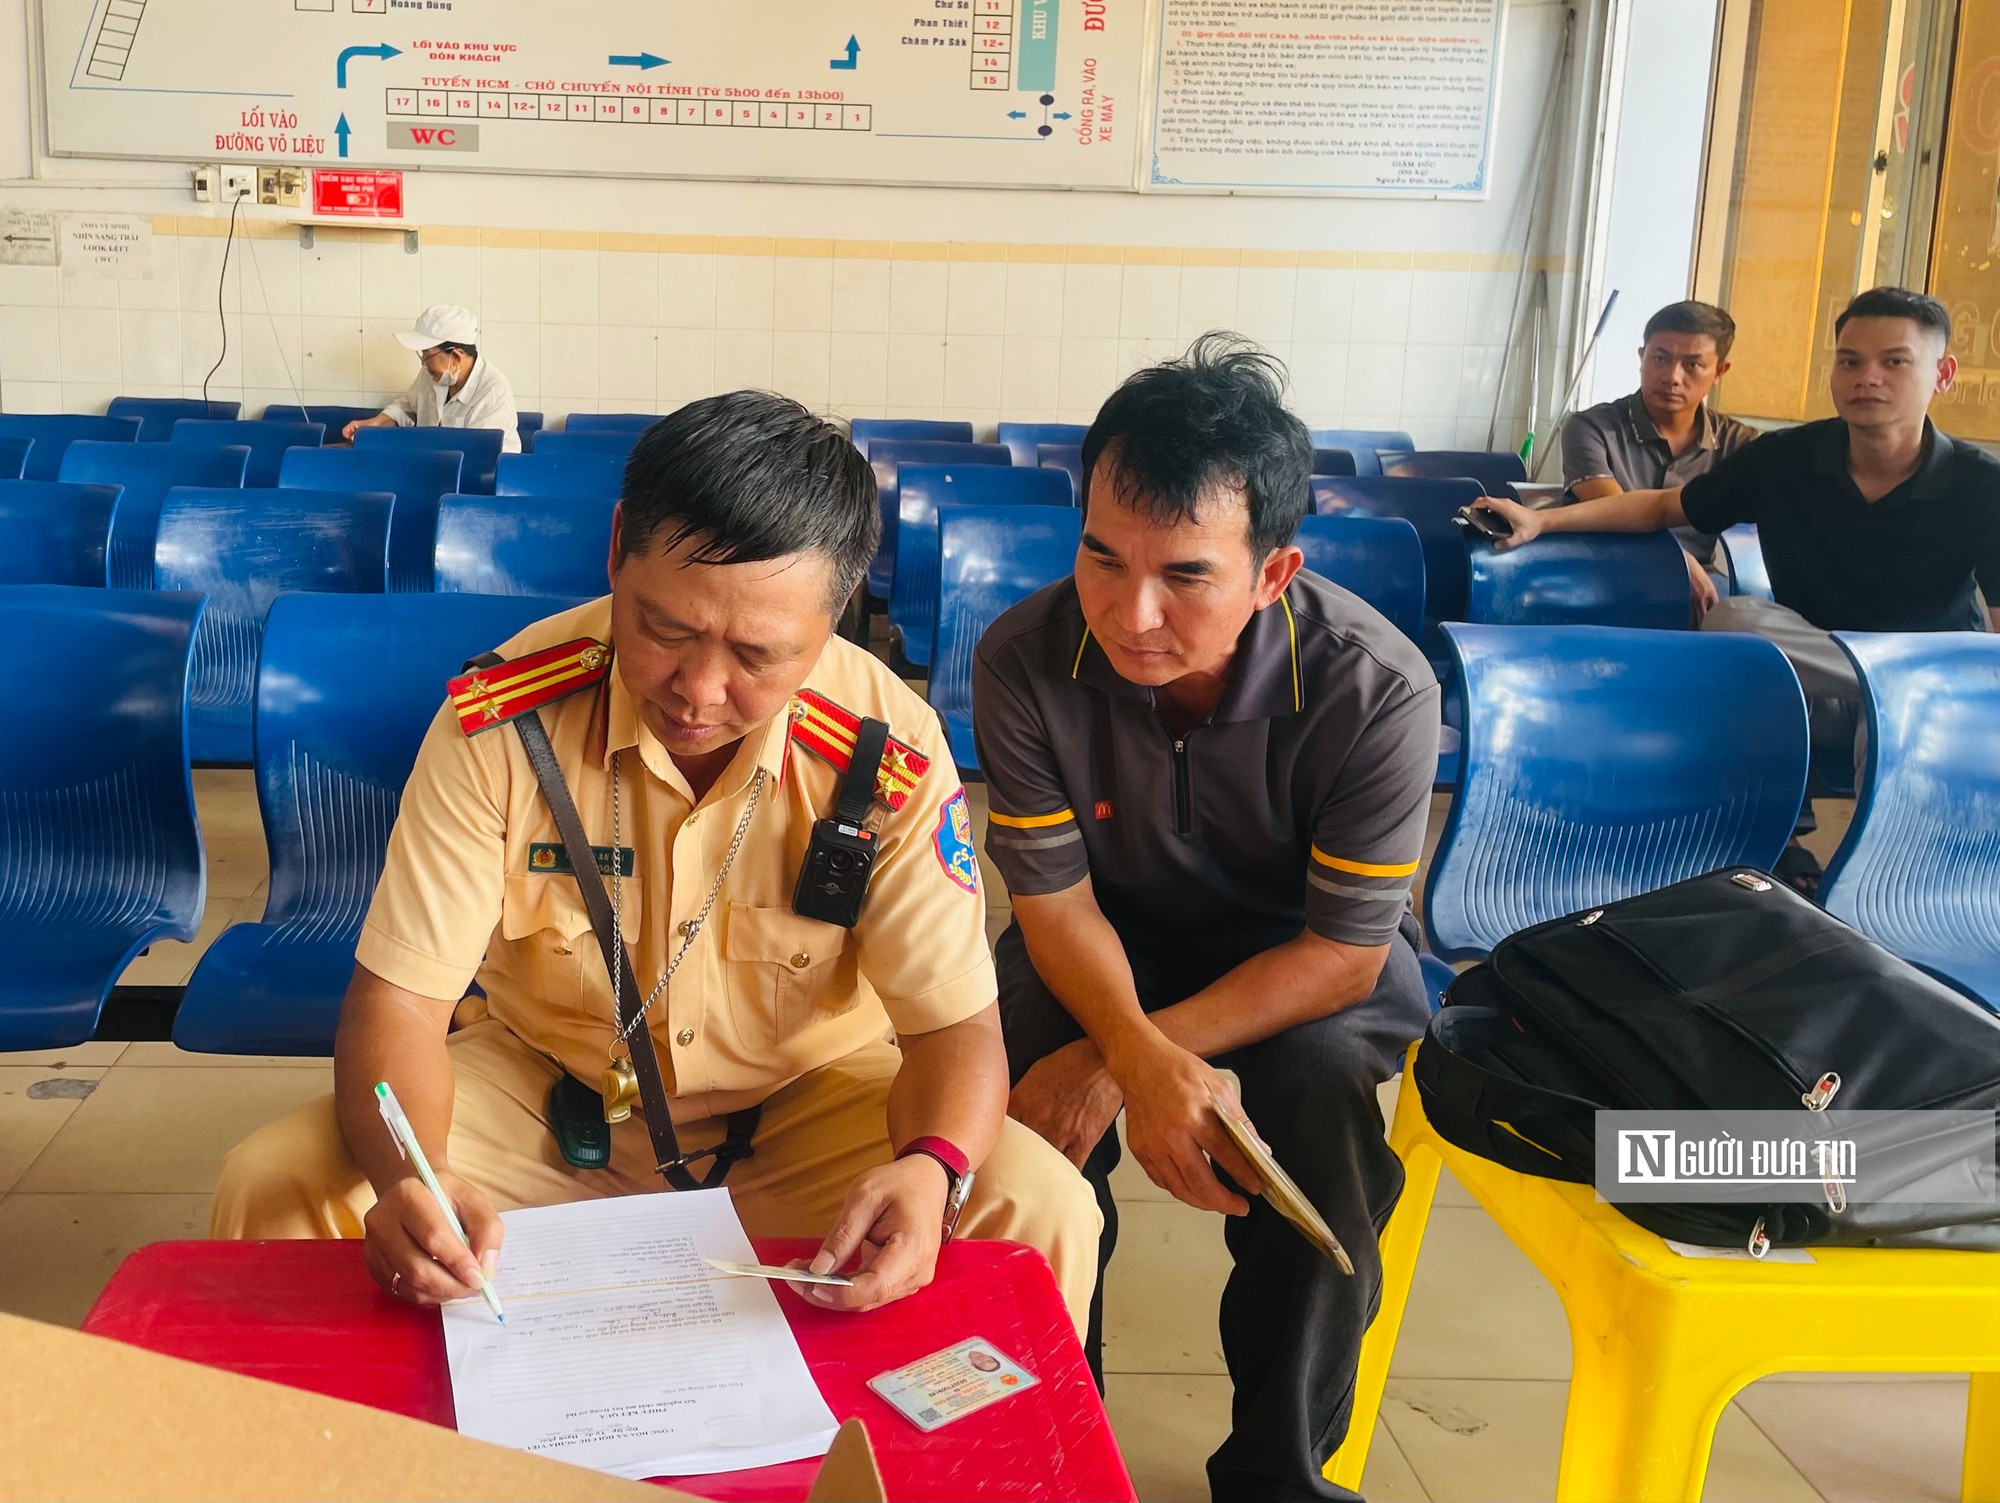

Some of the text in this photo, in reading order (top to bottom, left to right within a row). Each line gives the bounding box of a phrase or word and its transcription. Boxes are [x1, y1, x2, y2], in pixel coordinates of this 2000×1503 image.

[986, 2, 999, 10] 11
[914, 18, 938, 27] Phan
[1082, 0, 1106, 31] ĐƯ
[985, 21, 1000, 29] 12
[1031, 10, 1047, 40] KHU
[413, 39, 517, 53] LỐI VÀO KHU VỰC
[932, 37, 945, 46] Pa
[982, 39, 1004, 47] 12+
[430, 52, 501, 62] ĐÓN KHÁCH
[983, 58, 998, 66] 14
[1083, 58, 1097, 82] VÀO
[983, 76, 997, 84] 15
[422, 75, 845, 101] TUYẾN HCM CHỜ CHUYẾN NỘI TỈNH (Từ 5h00 đến 13h00)
[395, 97, 860, 121] 17 16 15 14 12+ 12 11 10 9 8 7 6 5 4 3 2 1
[241, 105, 297, 129] LỐI VÀO
[1099, 95, 1114, 142] XE MÁY
[1074, 106, 1093, 145] CỔNG
[410, 128, 456, 145] WC
[215, 132, 325, 157] ĐƯỜNG VÕ LIỆU
[94, 233, 117, 241] SANG
